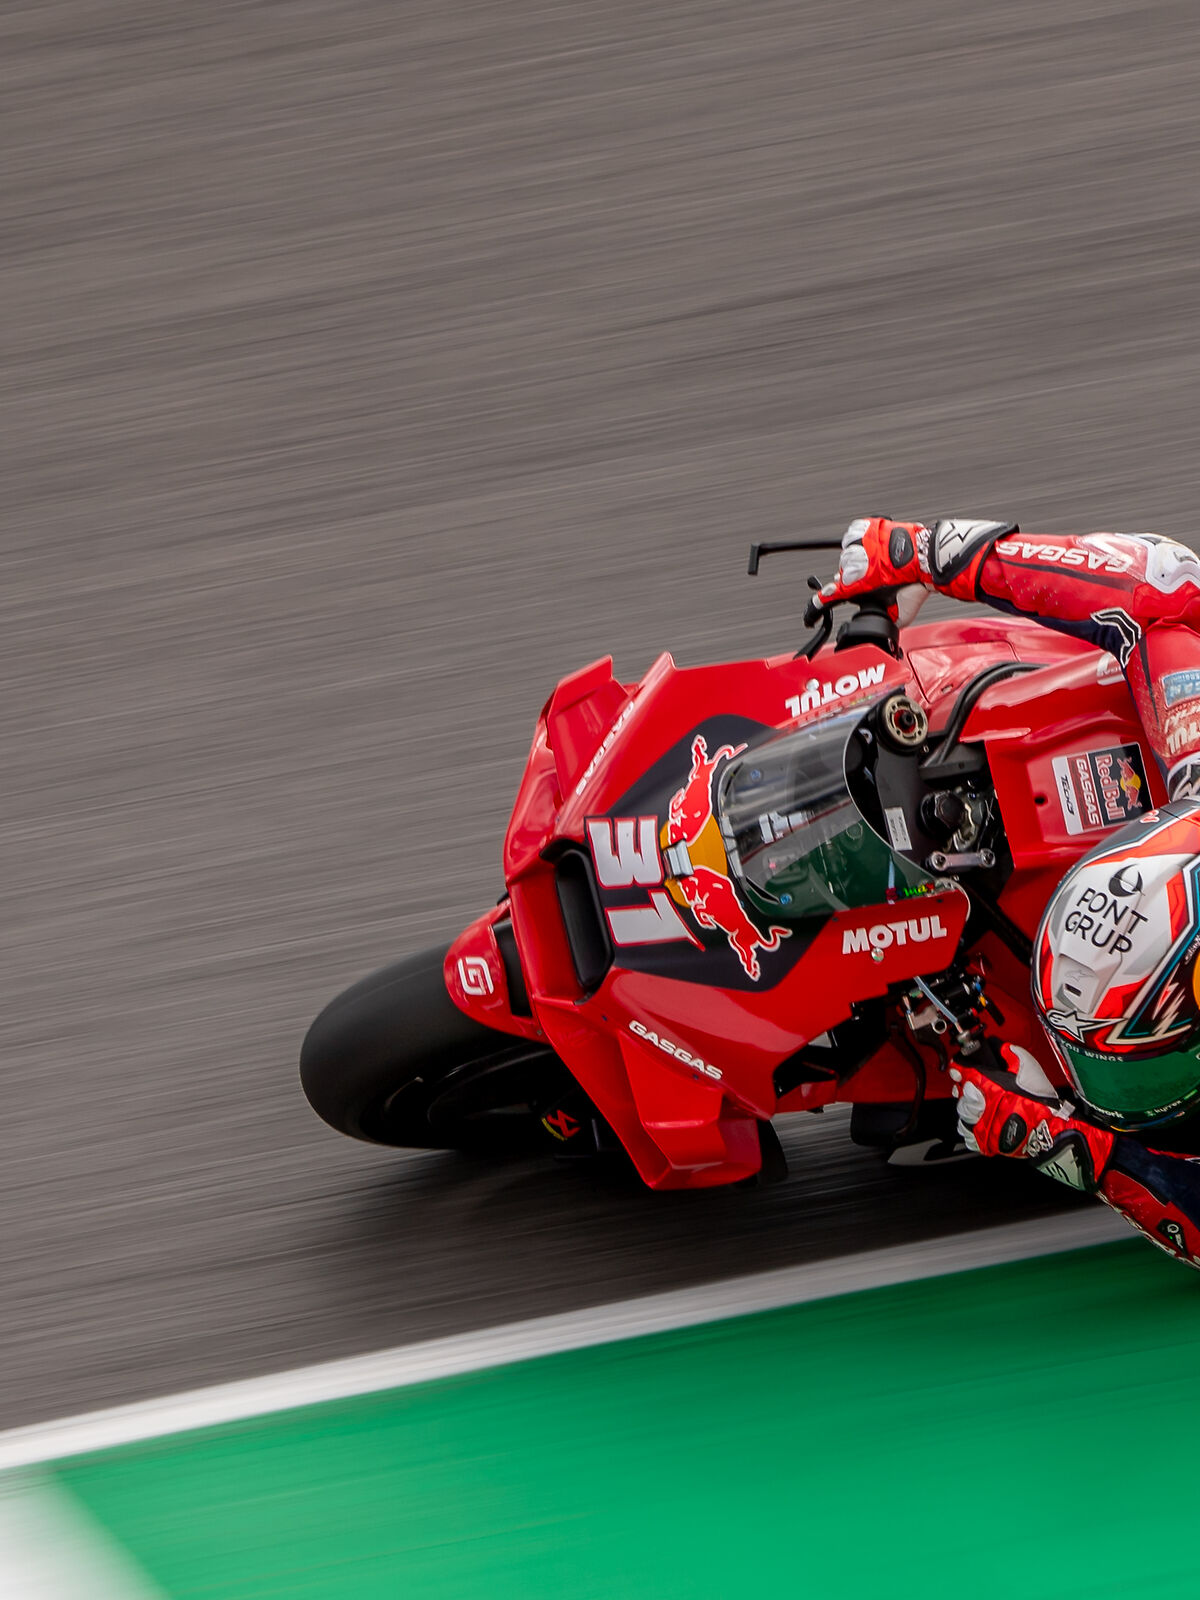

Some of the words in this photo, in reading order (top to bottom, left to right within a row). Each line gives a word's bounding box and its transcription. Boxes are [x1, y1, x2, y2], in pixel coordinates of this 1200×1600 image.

[996, 541, 1134, 573] GASGAS
[785, 663, 885, 718] MOTUL
[576, 701, 634, 796] GASGAS
[1076, 759, 1099, 825] GASGAS
[584, 814, 706, 952] 31
[842, 915, 947, 954] MOTUL
[1065, 910, 1133, 955] GRUP
[1076, 887, 1149, 934] FONT
[628, 1020, 723, 1080] GASGAS
[1085, 1050, 1124, 1063] WINGS
